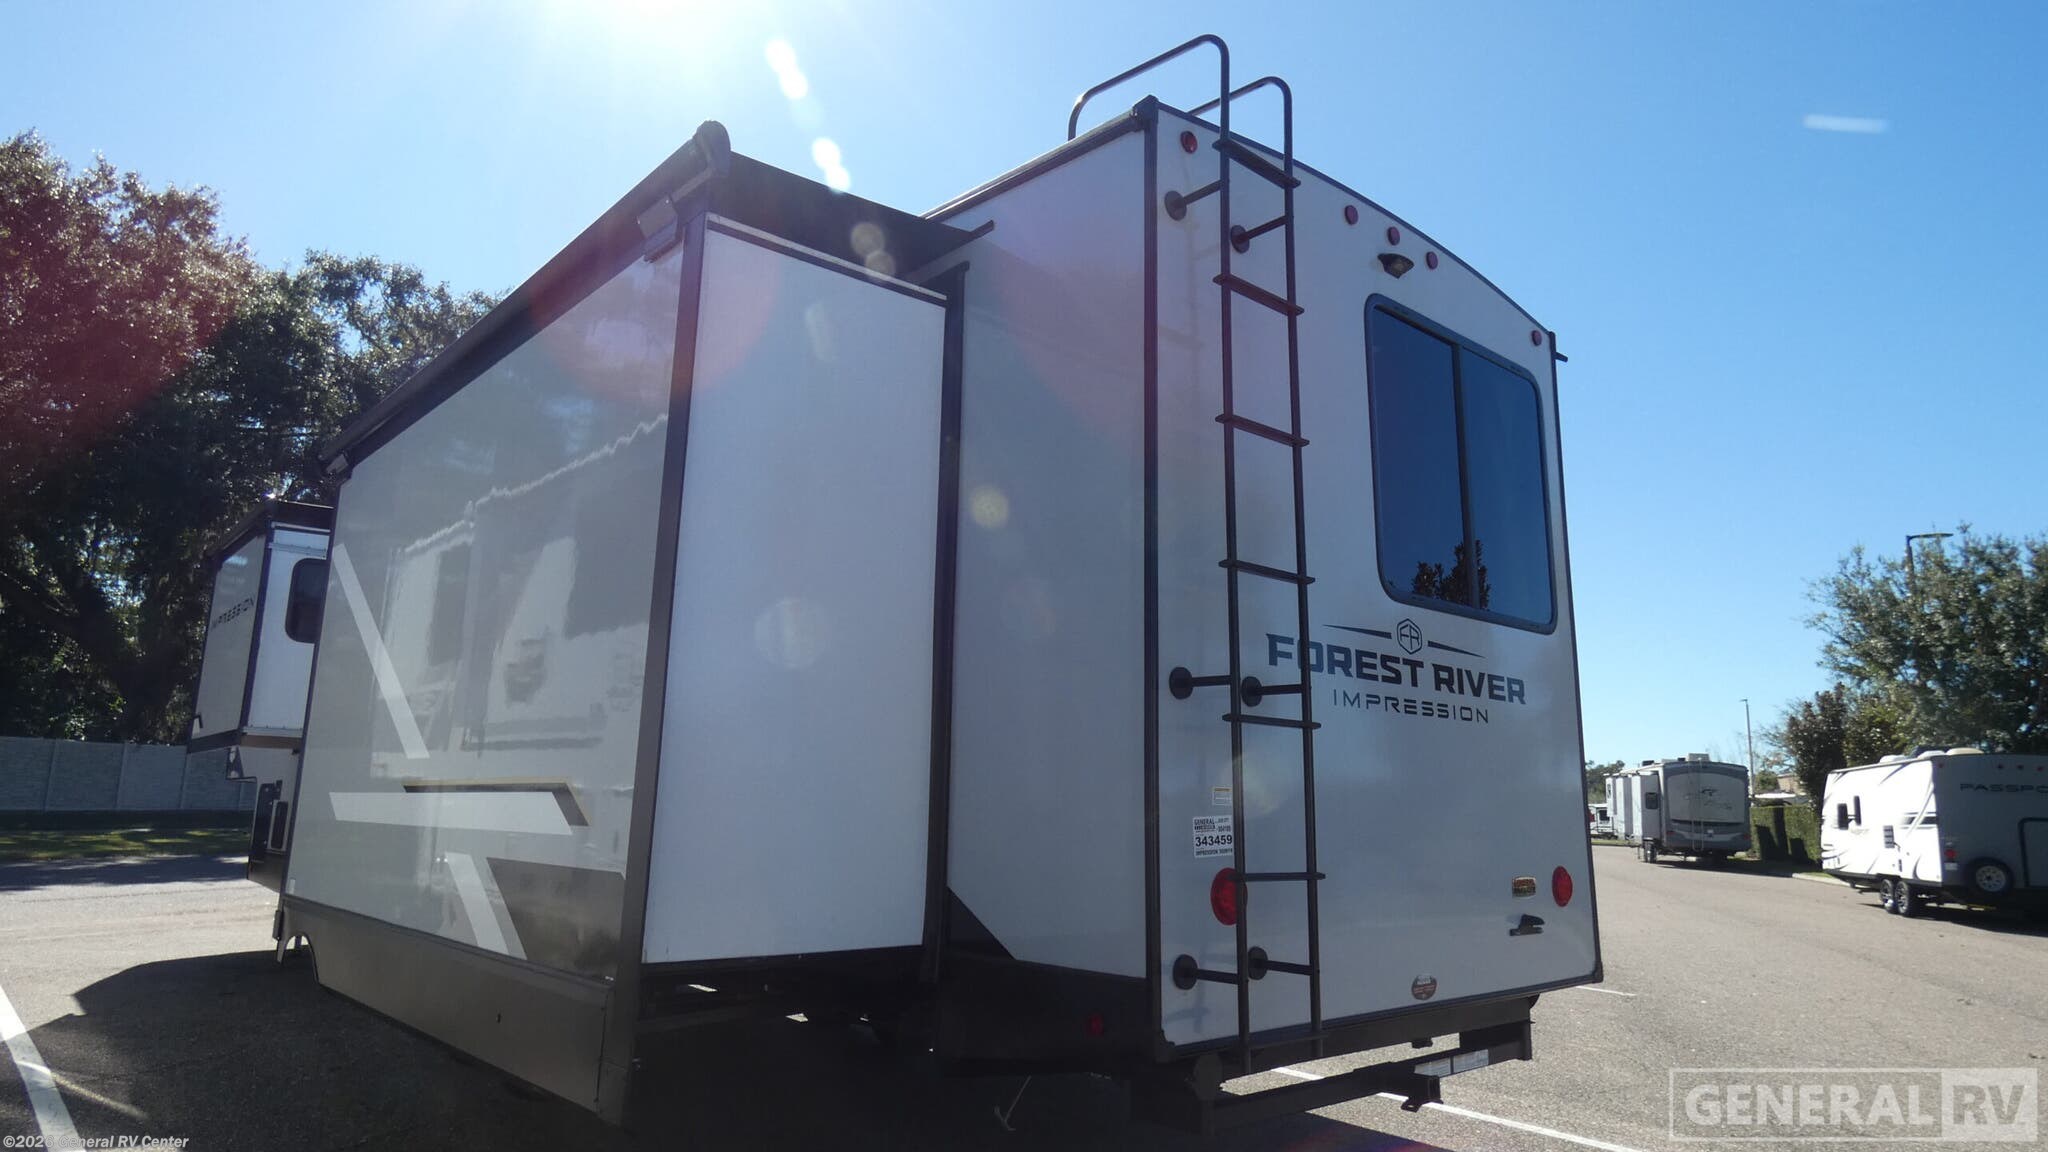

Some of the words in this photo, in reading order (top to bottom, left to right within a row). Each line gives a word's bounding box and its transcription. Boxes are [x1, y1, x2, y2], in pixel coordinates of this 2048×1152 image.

[1265, 633, 1424, 688] FOREST
[1432, 663, 1526, 704] RIVER
[1333, 689, 1489, 723] IMPRESSION
[1195, 835, 1232, 847] 343459
